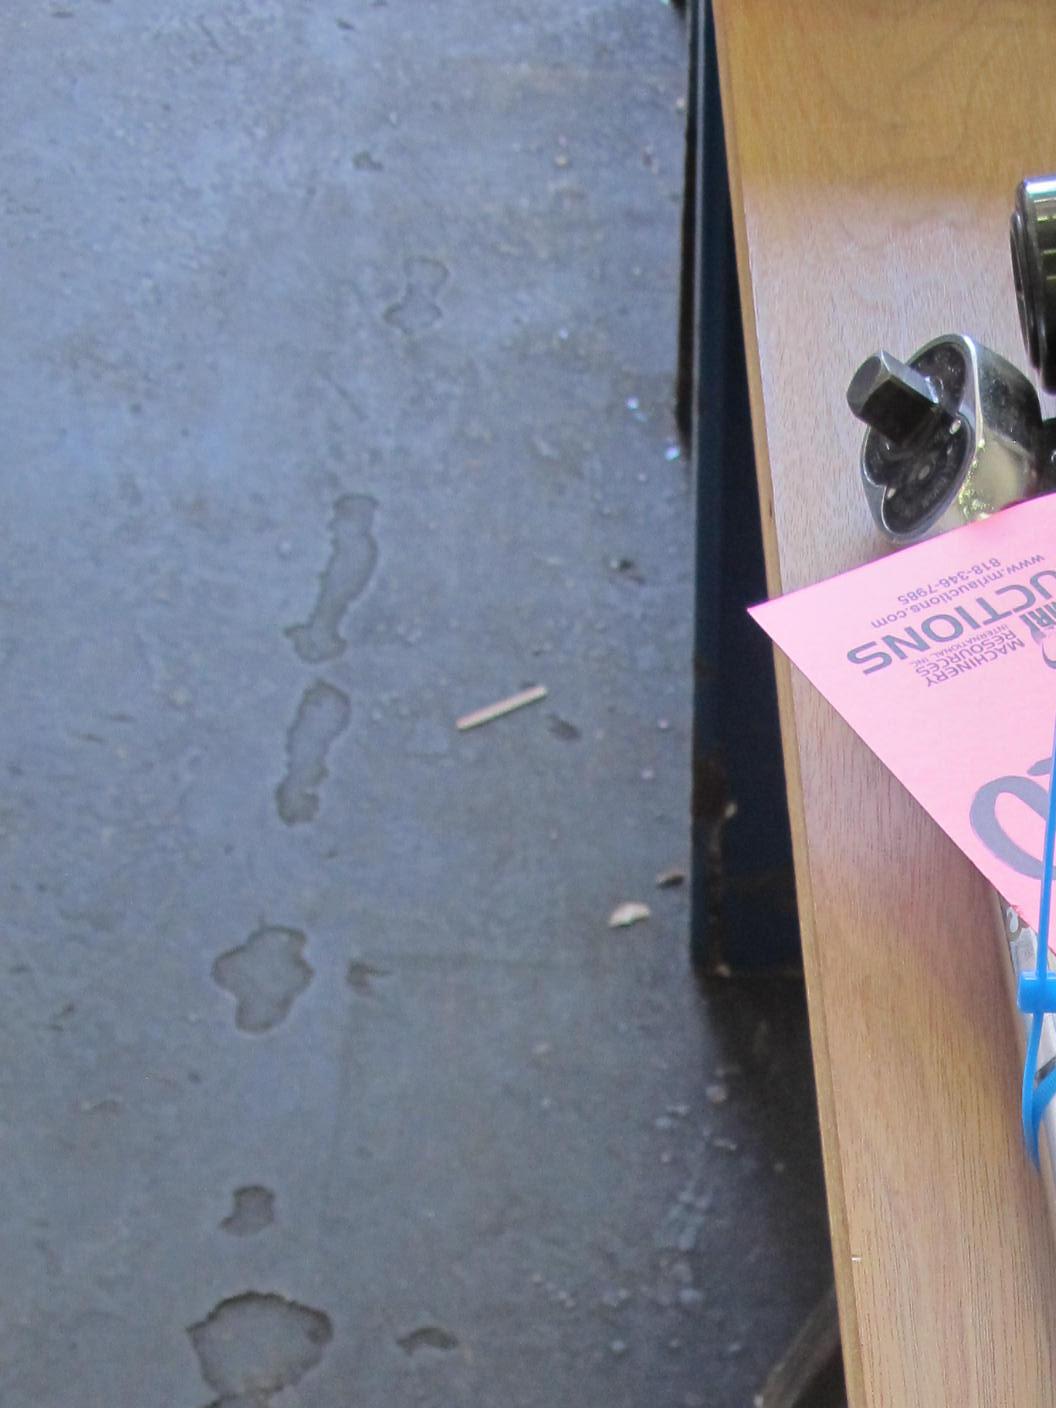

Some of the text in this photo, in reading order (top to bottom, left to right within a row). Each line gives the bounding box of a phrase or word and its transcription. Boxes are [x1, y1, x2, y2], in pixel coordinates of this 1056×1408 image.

[871, 553, 1046, 628] www.mriauctions.com
[897, 557, 1001, 606] 818-346-7985
[915, 629, 1017, 677] RESOURCES
[925, 636, 1025, 689] MACHINERY
[936, 624, 1010, 659] INTERNATIONAL
